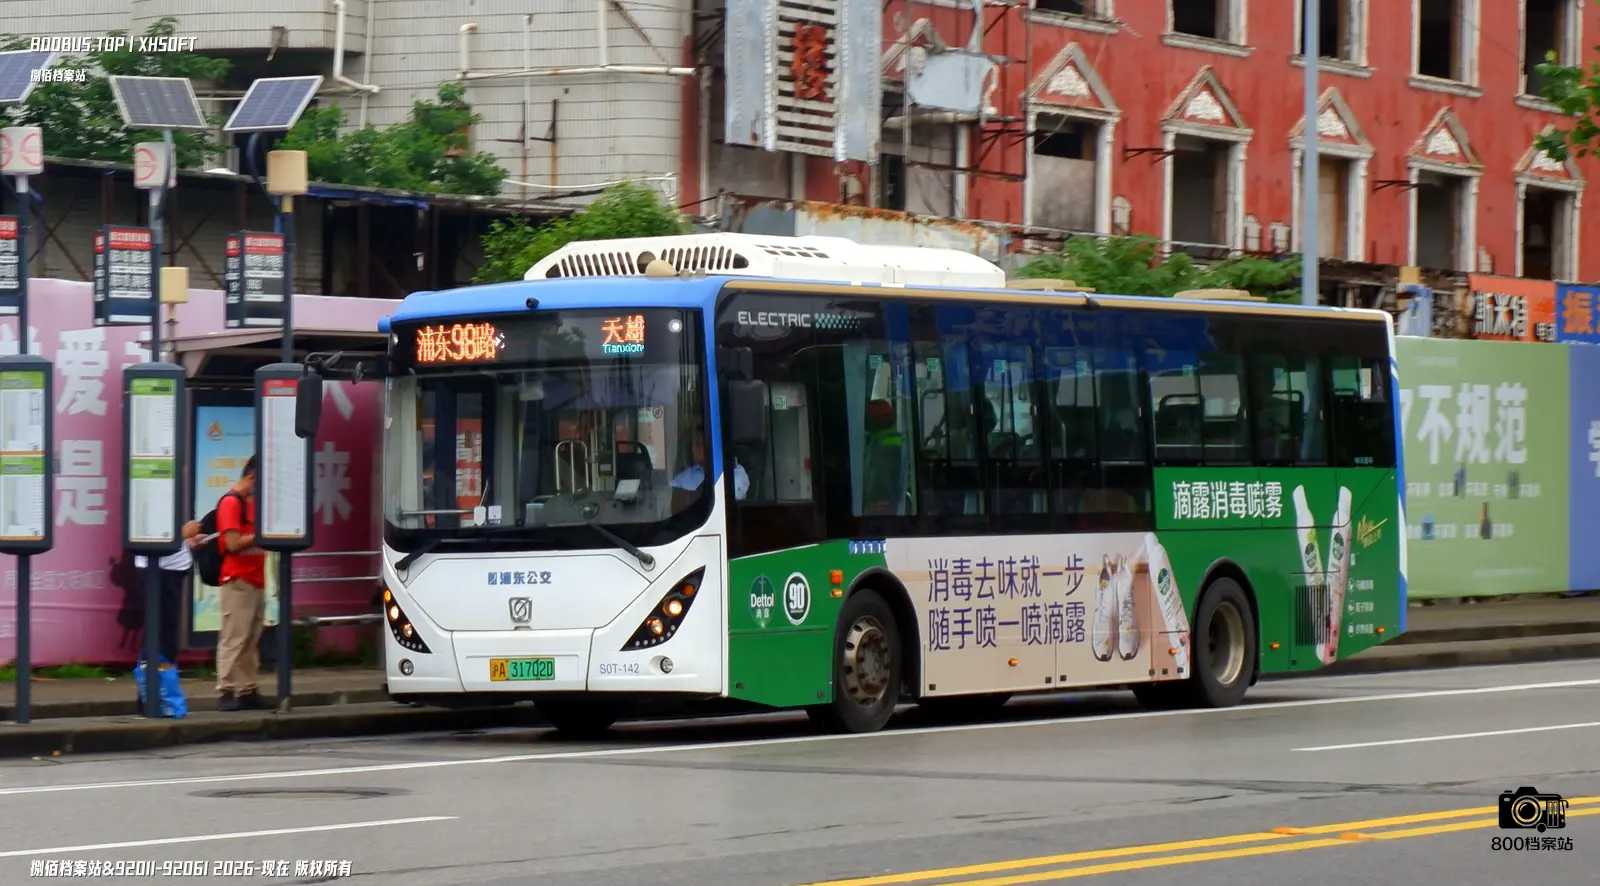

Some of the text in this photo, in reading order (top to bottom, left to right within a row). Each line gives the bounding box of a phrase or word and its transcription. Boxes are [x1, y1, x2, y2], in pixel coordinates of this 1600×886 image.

[415, 313, 646, 363] 浦东98路 天雄
[737, 310, 811, 327] ELECTRIC
[56, 327, 110, 416] 爱
[55, 440, 109, 527] 是
[1172, 480, 1283, 520] 滴露消毒喷雾
[499, 571, 552, 586] 浦东公交
[789, 582, 805, 610] 90
[927, 553, 1085, 603] 消毒去味就一步
[750, 592, 774, 608] Dettol
[928, 601, 1086, 652] 随手喷一喷滴露
[511, 659, 554, 678] 31702D
